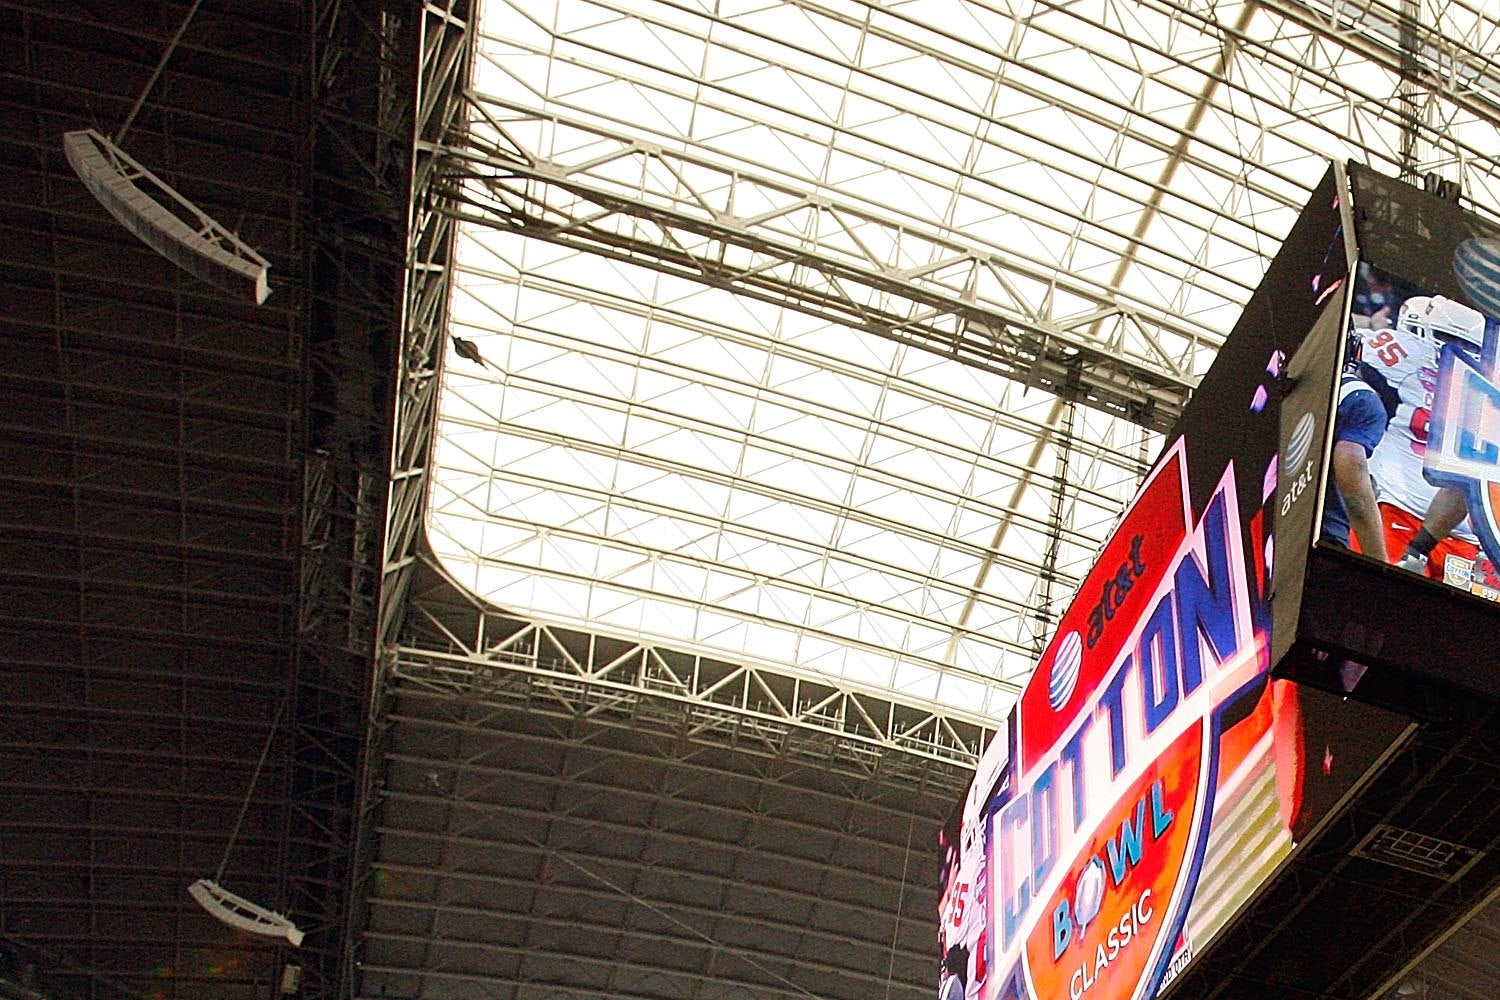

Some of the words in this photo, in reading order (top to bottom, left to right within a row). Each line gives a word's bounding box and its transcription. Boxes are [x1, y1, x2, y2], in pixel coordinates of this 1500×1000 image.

[1367, 331, 1408, 367] 95
[1281, 460, 1314, 516] at&t
[1086, 533, 1146, 650] at&t
[1001, 486, 1238, 952] COTTON
[1053, 779, 1173, 963] BOWL
